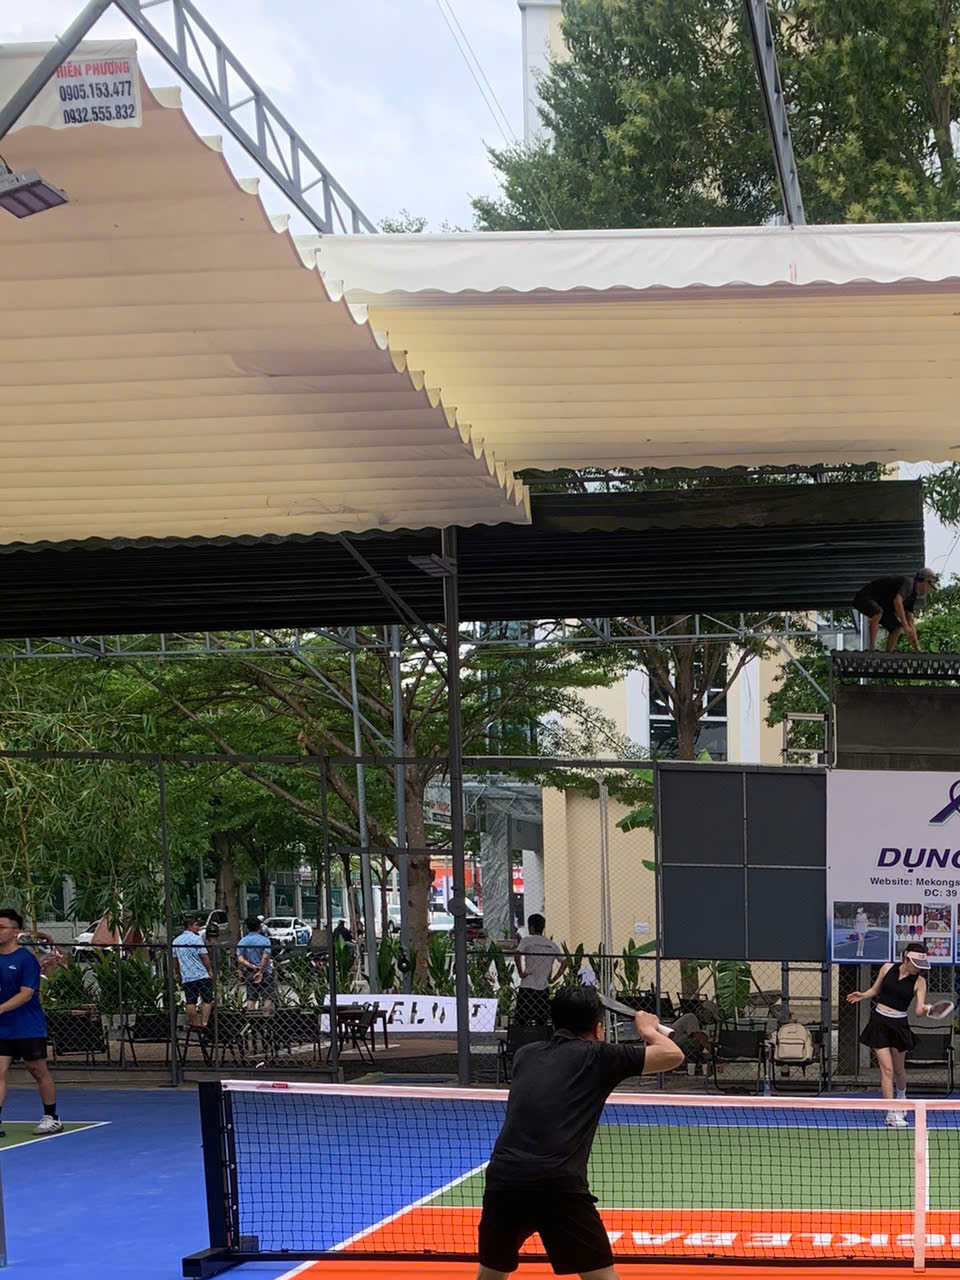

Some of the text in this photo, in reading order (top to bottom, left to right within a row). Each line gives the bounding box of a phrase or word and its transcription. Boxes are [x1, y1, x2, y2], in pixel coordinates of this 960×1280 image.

[59, 81, 132, 102] 0905.153.477
[63, 104, 136, 124] 0932.555.832
[870, 877, 913, 886] Website:
[924, 889, 943, 897] ĐC:
[945, 889, 958, 897] 39
